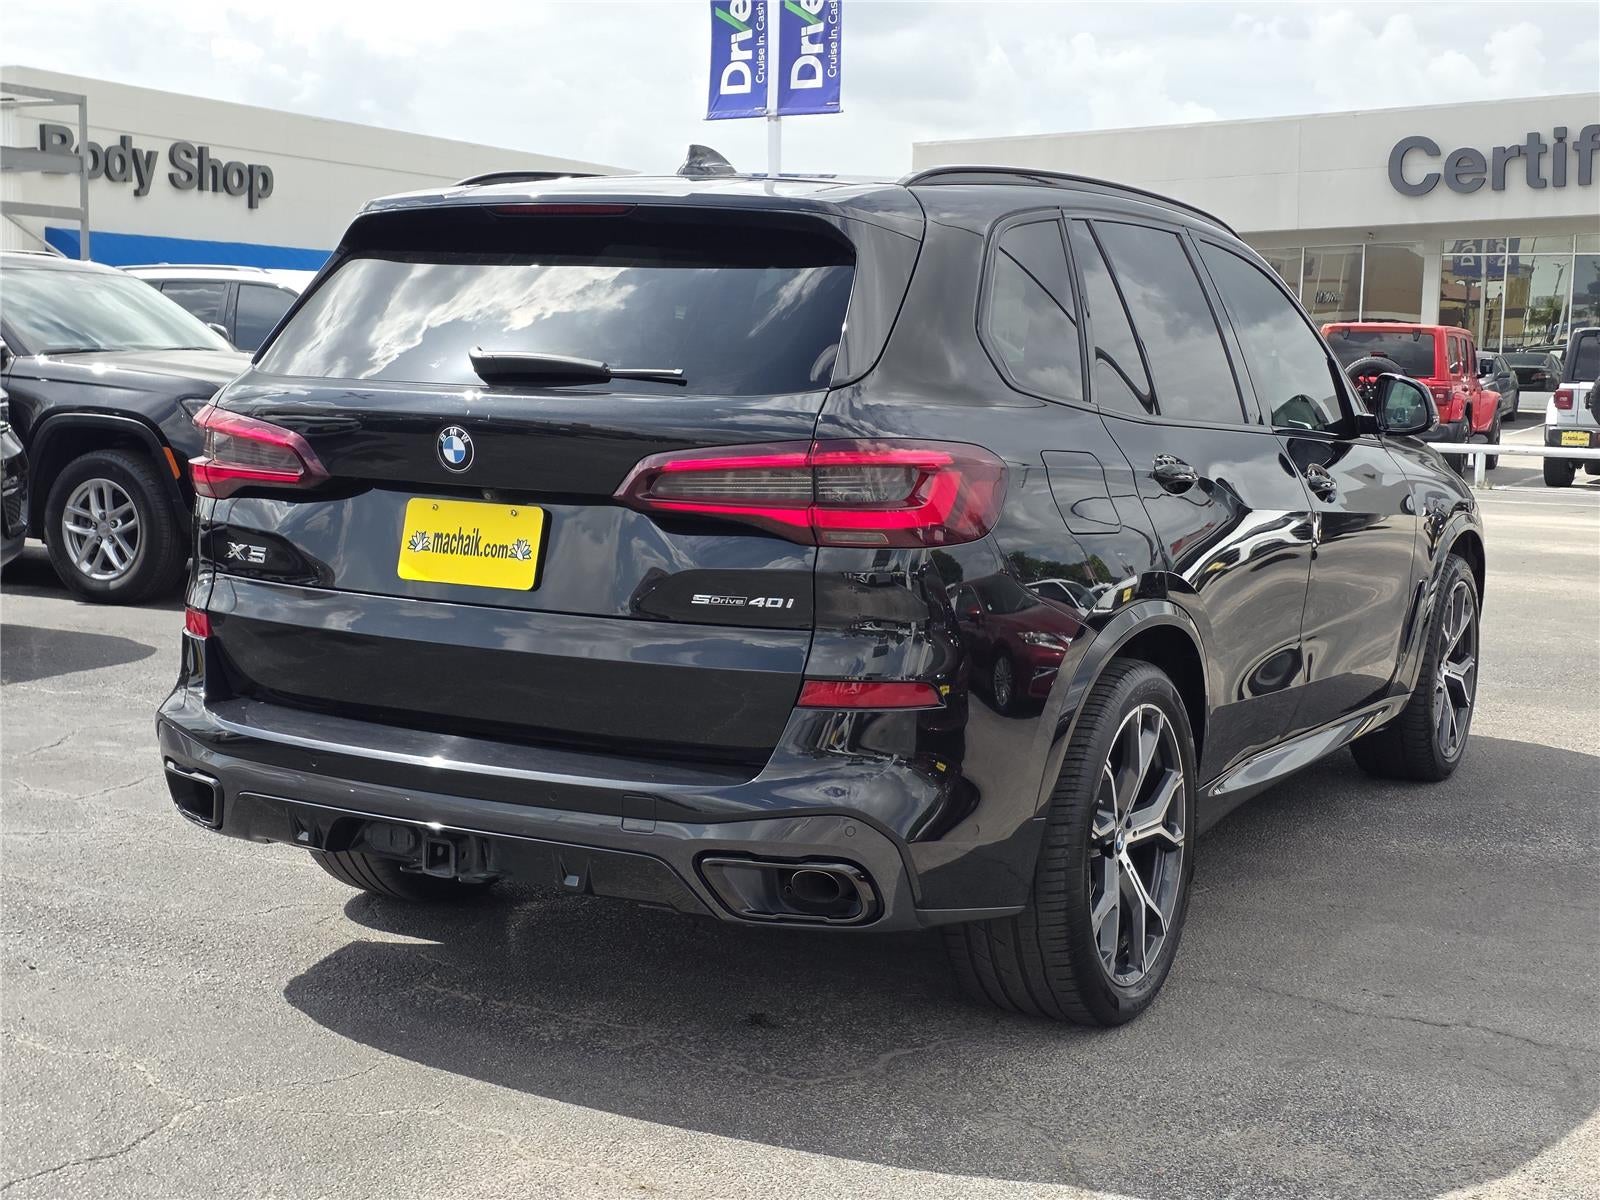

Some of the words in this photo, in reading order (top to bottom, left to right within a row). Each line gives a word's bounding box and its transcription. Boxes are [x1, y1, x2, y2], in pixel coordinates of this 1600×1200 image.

[756, 2, 765, 31] Cash
[828, 0, 838, 24] Cas
[756, 33, 765, 46] In.
[828, 26, 838, 39] In.
[755, 48, 765, 84] Cruise
[827, 41, 838, 78] Cruise
[168, 141, 274, 209] Shop
[1387, 124, 1600, 197] Certif
[439, 428, 470, 444] BMW
[224, 541, 267, 564] X5
[431, 527, 510, 559] machaik.com
